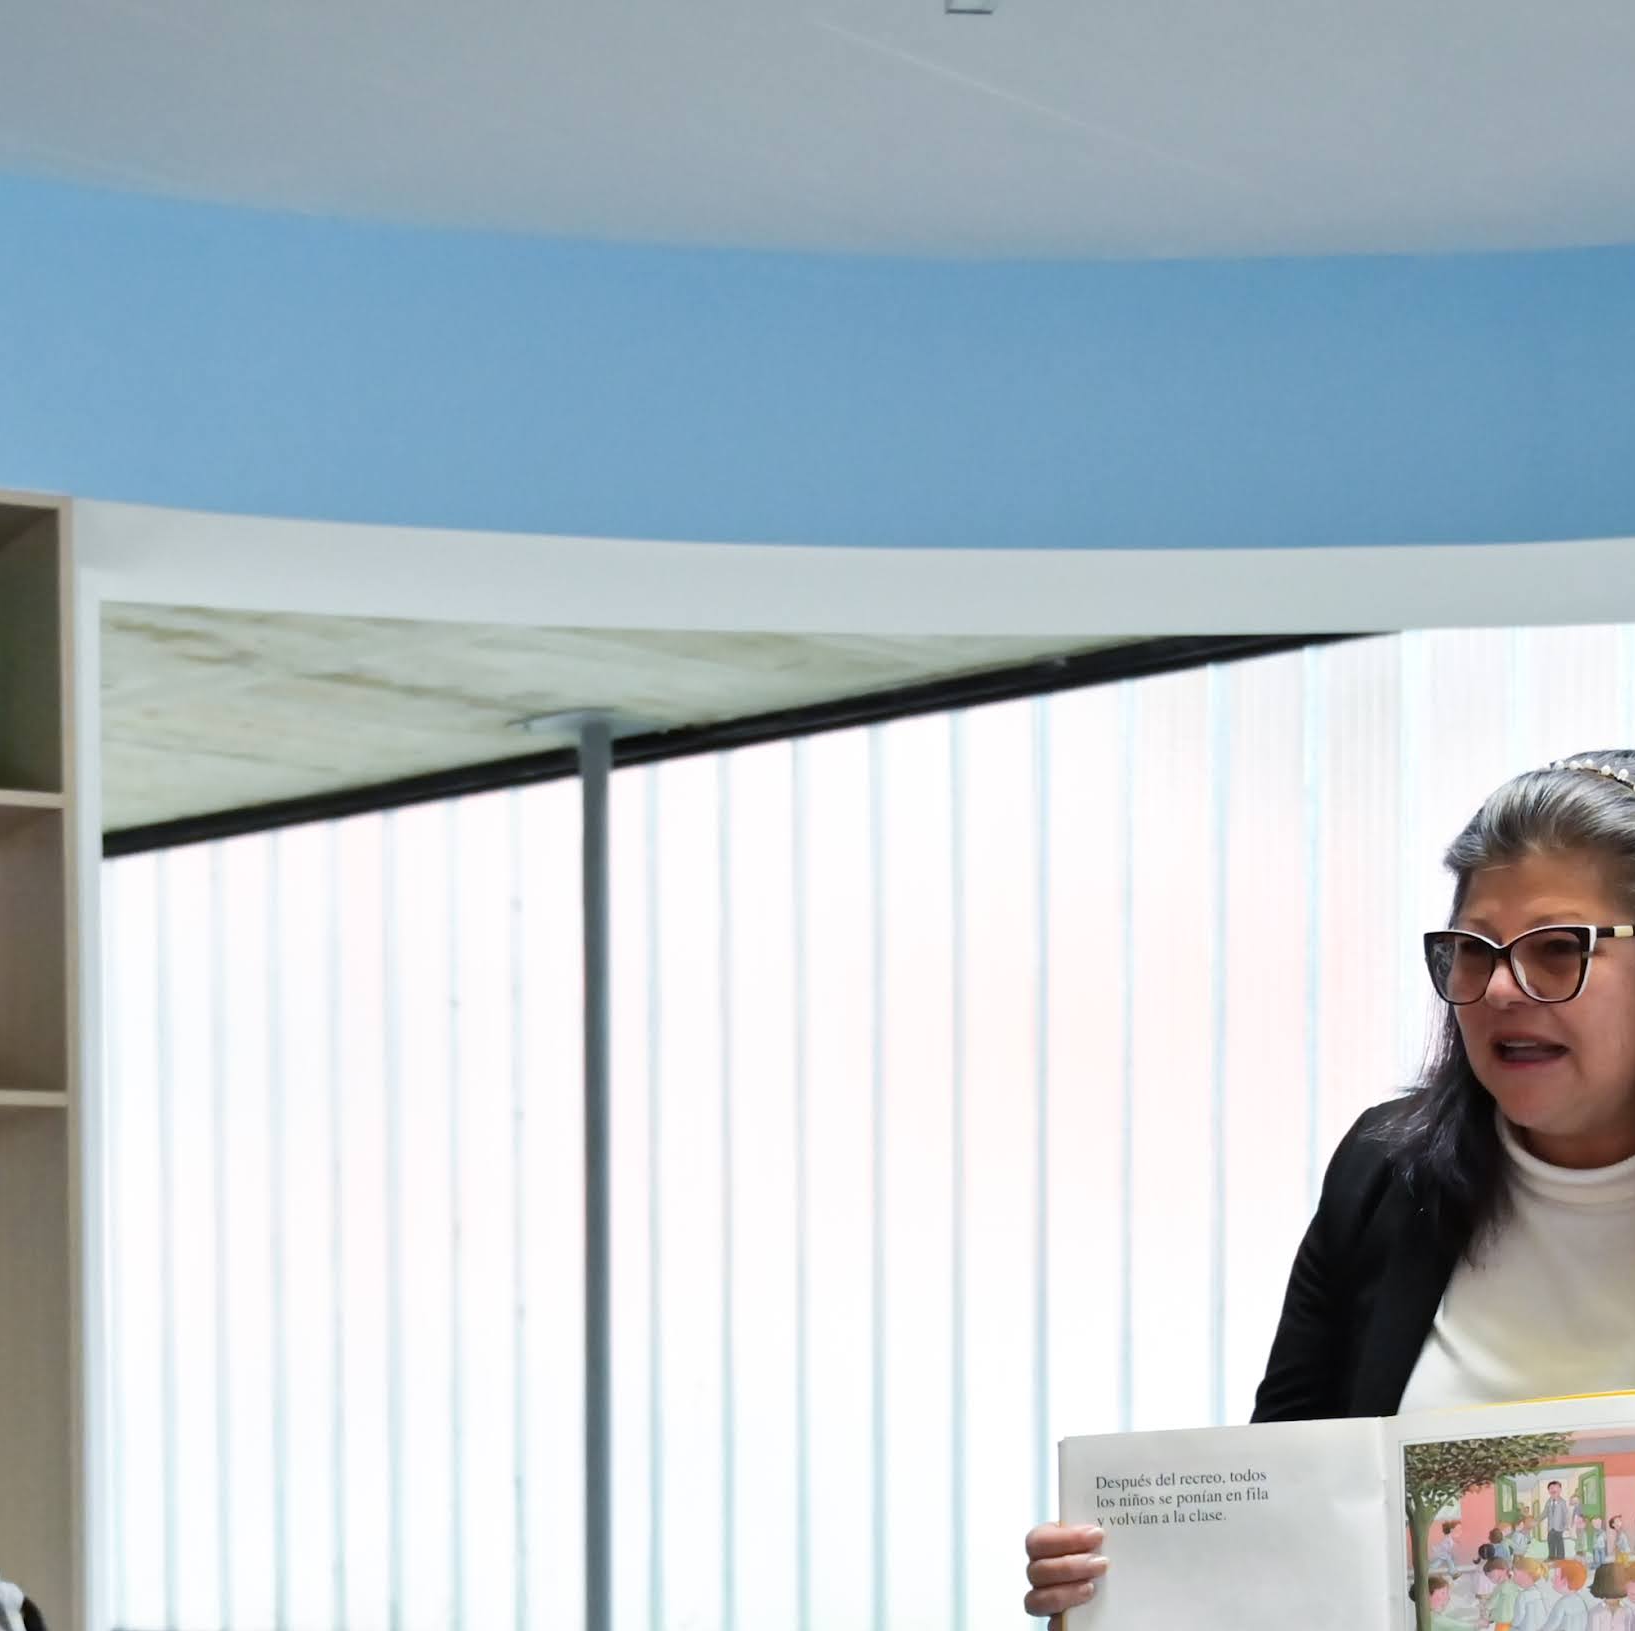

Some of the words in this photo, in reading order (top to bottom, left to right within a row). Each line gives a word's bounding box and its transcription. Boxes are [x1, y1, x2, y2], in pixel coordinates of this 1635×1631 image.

[1096, 1475, 1152, 1491] Después
[1155, 1473, 1176, 1486] del
[1179, 1472, 1226, 1485] recreo,
[1230, 1469, 1267, 1482] todos
[1096, 1495, 1116, 1508] los
[1119, 1493, 1155, 1507] niños
[1159, 1494, 1173, 1504] se
[1177, 1490, 1222, 1507] ponían
[1226, 1491, 1242, 1501] en
[1247, 1487, 1269, 1500] fila
[1097, 1517, 1105, 1528] y
[1109, 1512, 1158, 1526] volvían
[1162, 1514, 1170, 1523] a
[1173, 1510, 1186, 1523] la
[1189, 1509, 1227, 1522] clase.
